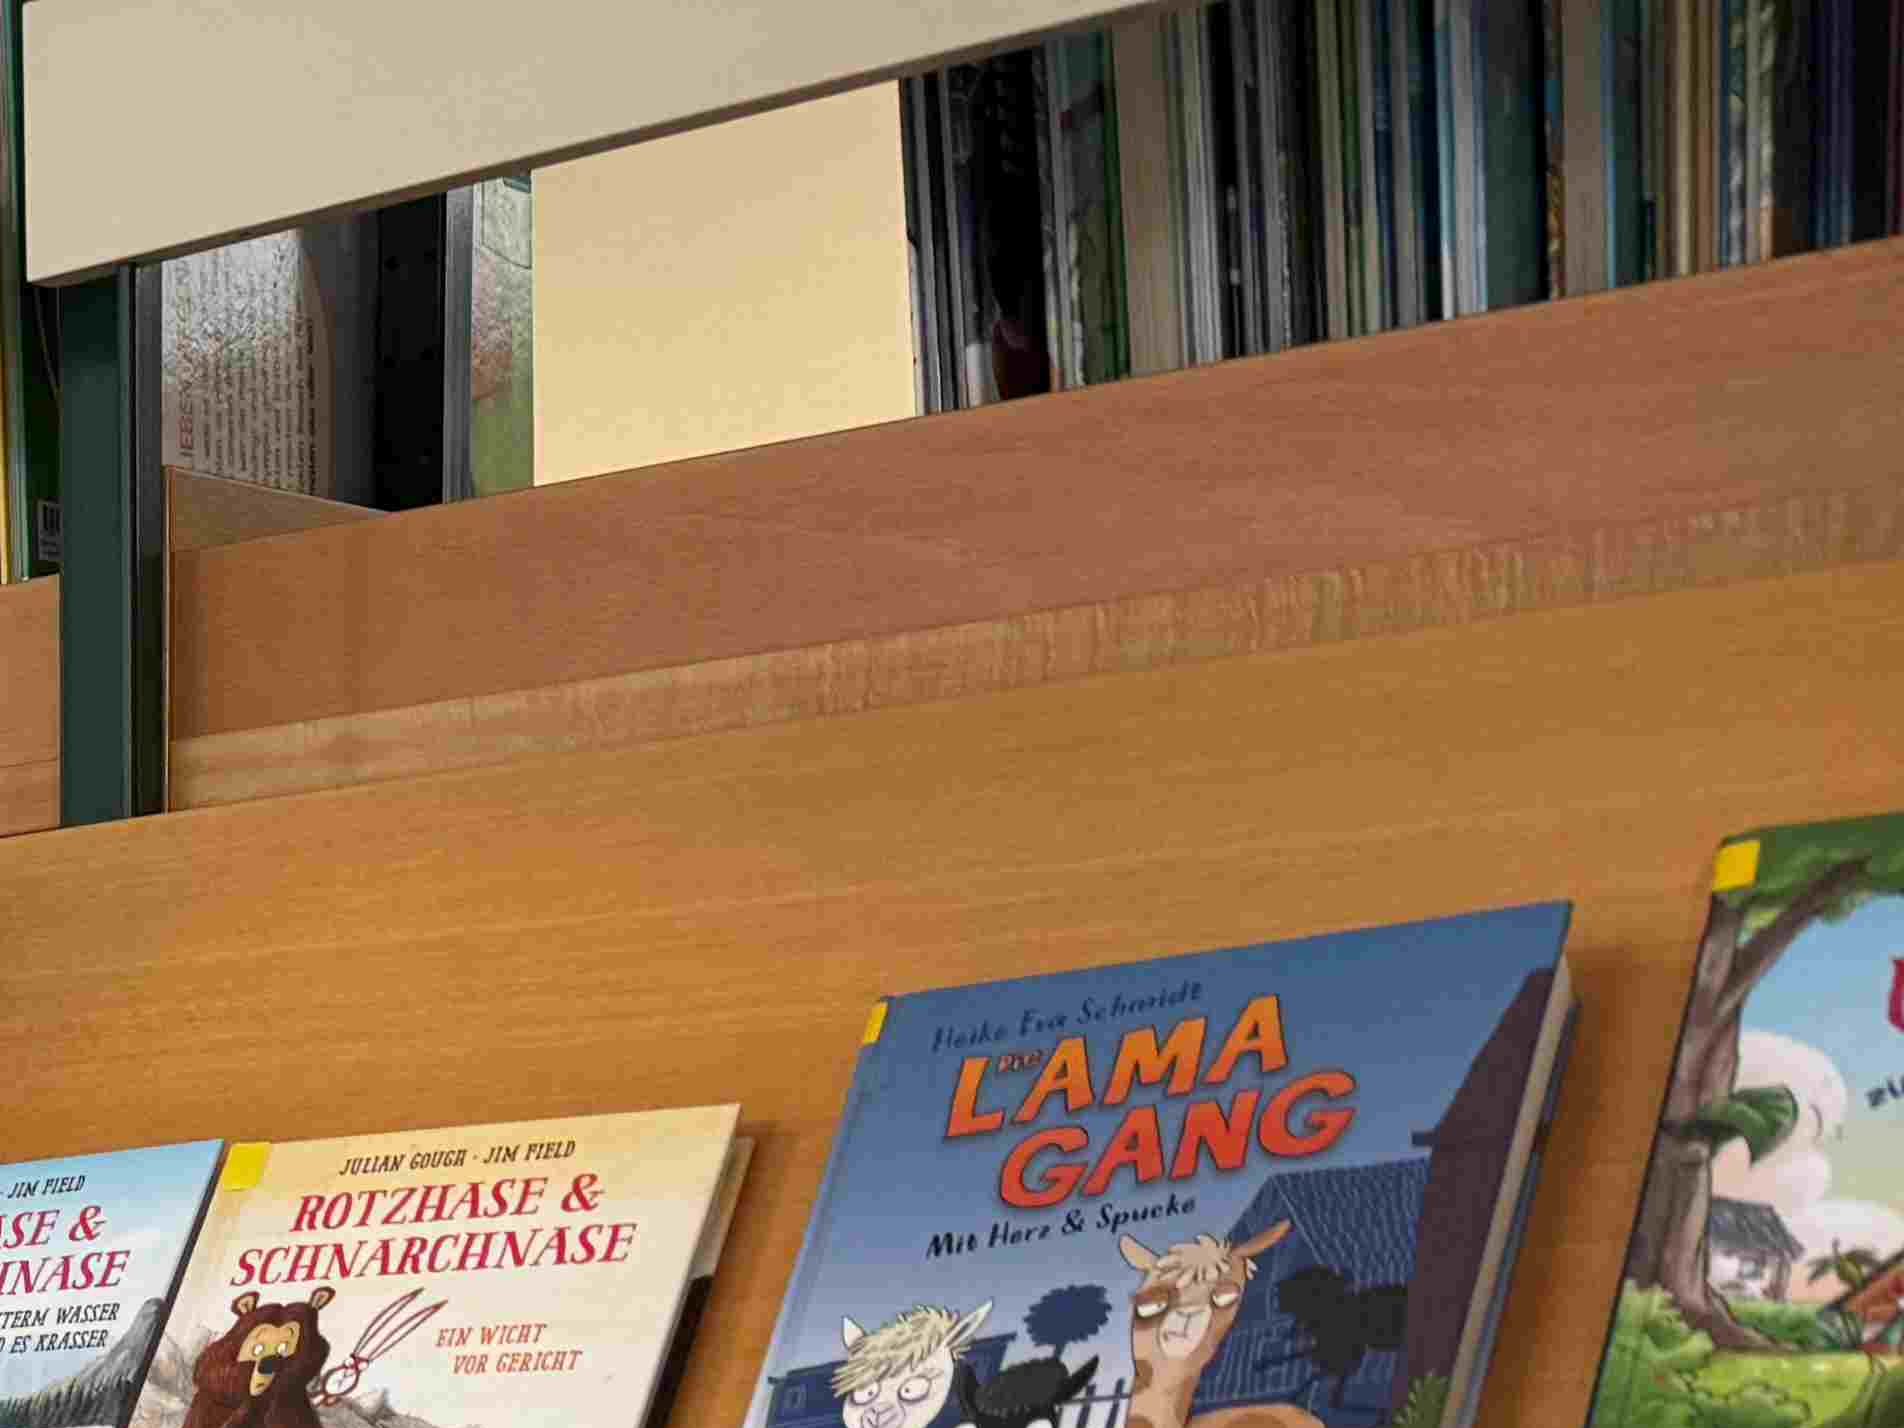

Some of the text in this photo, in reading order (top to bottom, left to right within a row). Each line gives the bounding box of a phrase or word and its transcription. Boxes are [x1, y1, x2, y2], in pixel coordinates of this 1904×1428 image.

[1022, 1007, 1068, 1038] Eva
[1077, 980, 1204, 1026] Schmidt
[944, 993, 1289, 1138] LAMA
[339, 1140, 577, 1176] JULIAN GOUGH JIM FIELD
[999, 1070, 1358, 1210] GANG
[8, 1181, 39, 1199] JIM
[42, 1174, 87, 1194] FIELD
[289, 1172, 606, 1234] ROTZHASE &
[68, 1204, 107, 1243] &
[926, 1192, 1198, 1261] Mit Herz & Spucke
[230, 1222, 639, 1287] SCHNARCHNASE
[56, 1303, 121, 1325] WASSER
[10, 1335, 28, 1355] ES
[33, 1329, 110, 1352] KRASSER
[435, 1322, 549, 1348] EIN WICHT
[454, 1349, 584, 1375] VOR GERICHT
